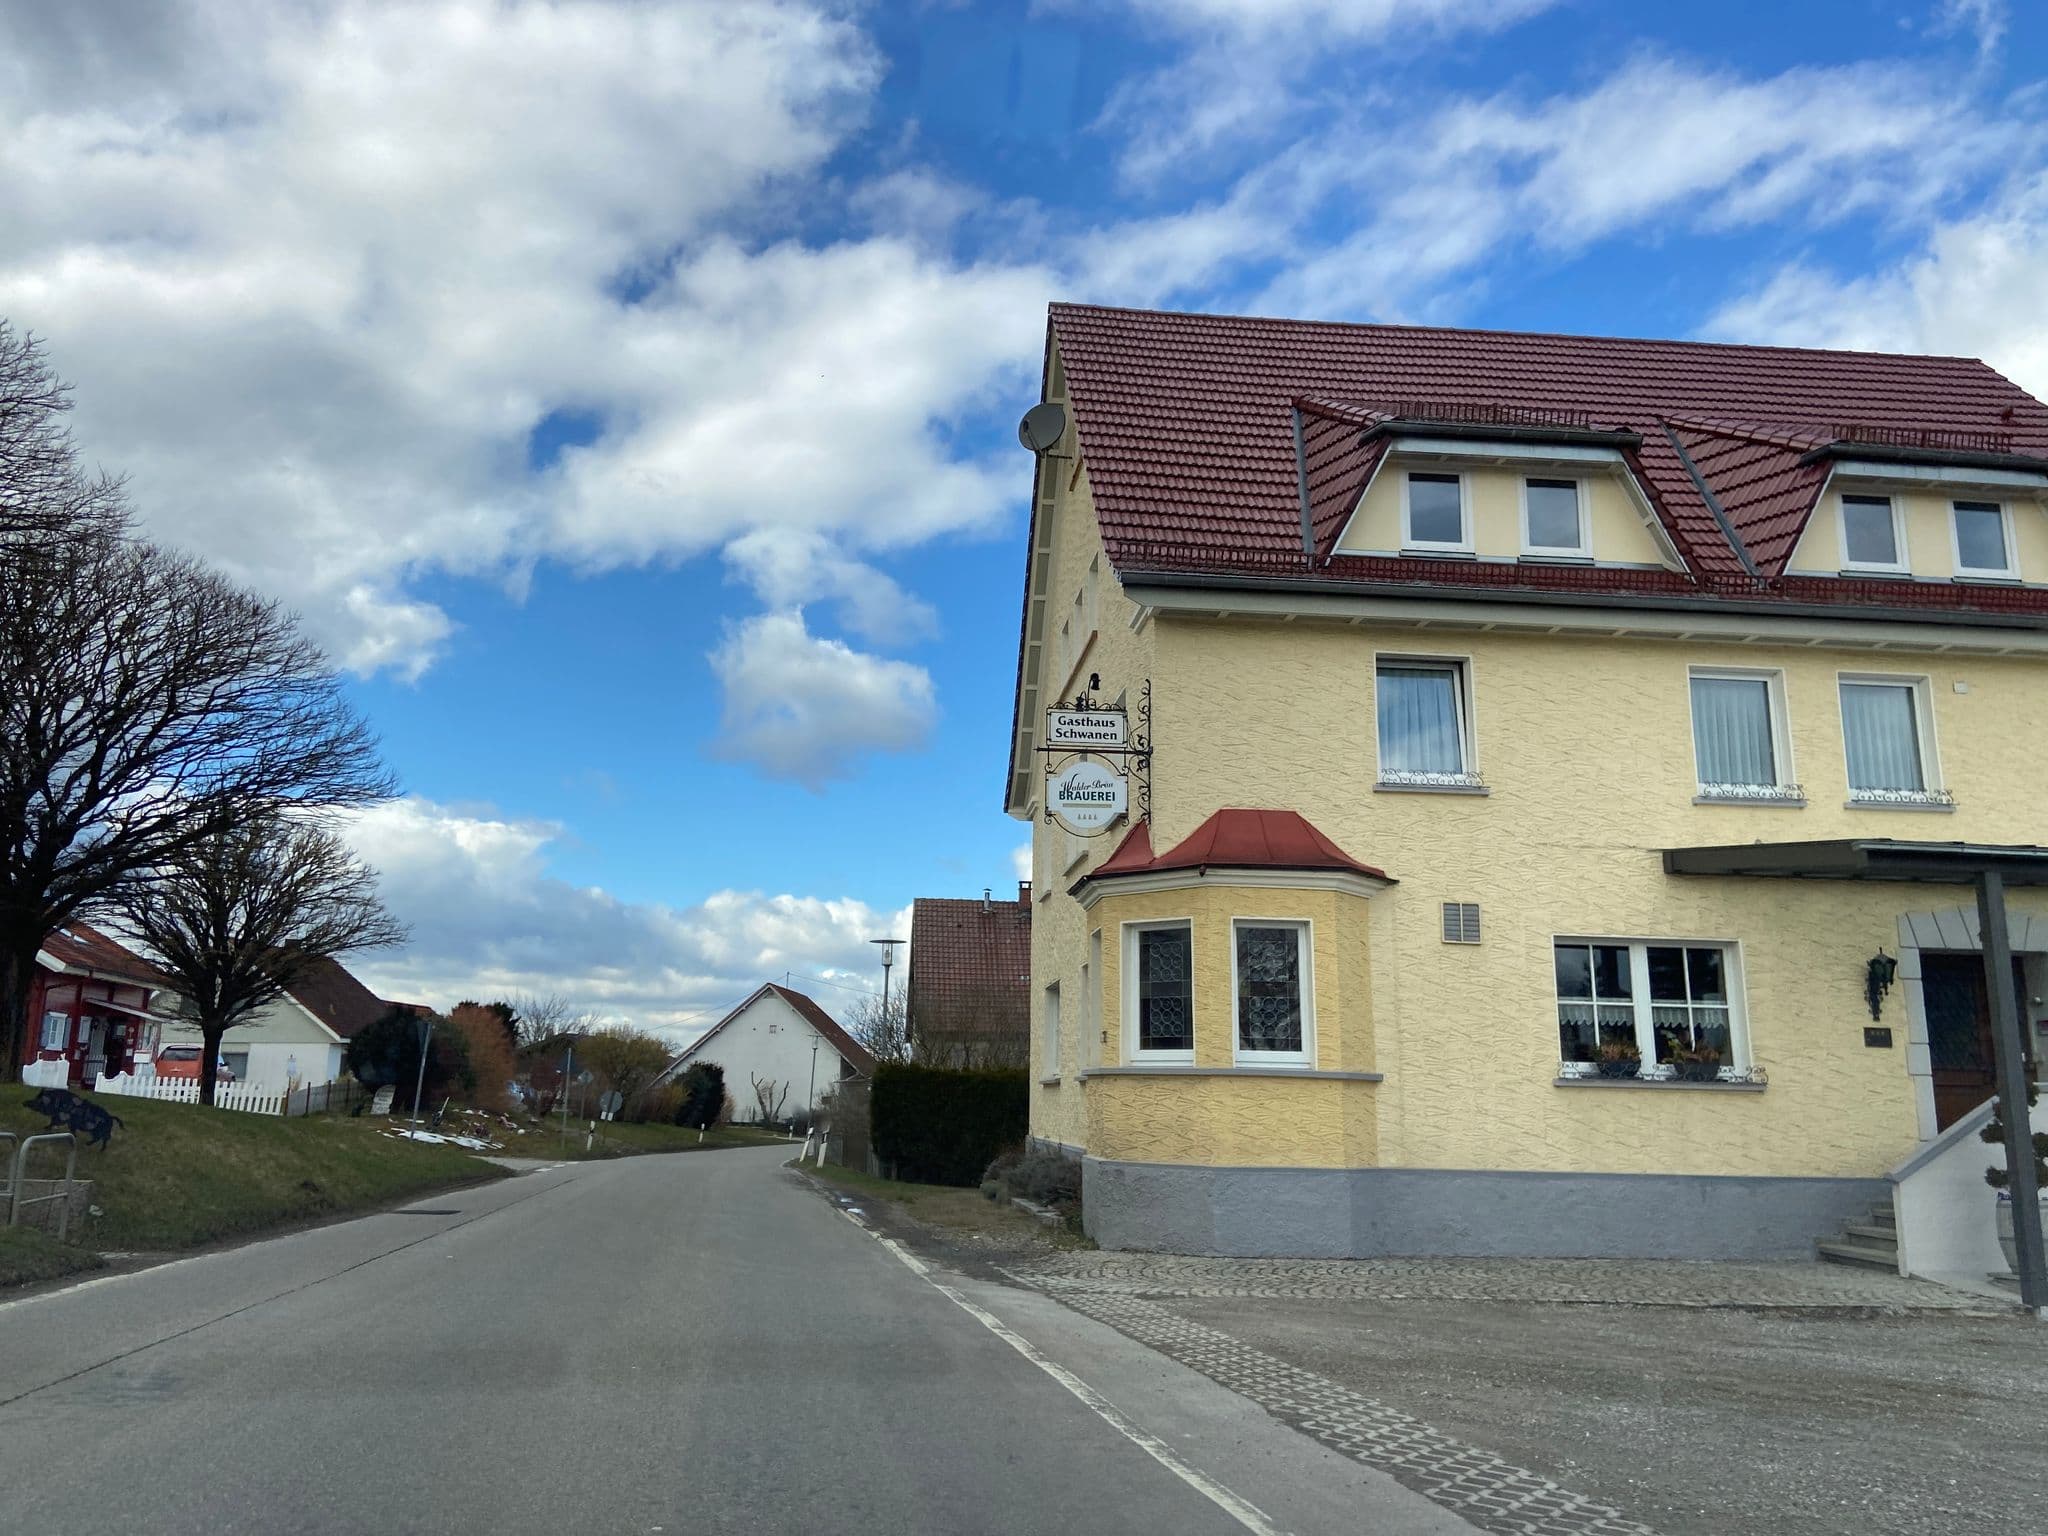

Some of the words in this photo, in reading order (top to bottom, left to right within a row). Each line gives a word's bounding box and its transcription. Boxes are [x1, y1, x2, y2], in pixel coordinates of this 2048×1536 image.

[1058, 715, 1116, 728] Gasthaus
[1055, 728, 1118, 740] Schwanen
[1058, 791, 1116, 802] BRAUEREI
